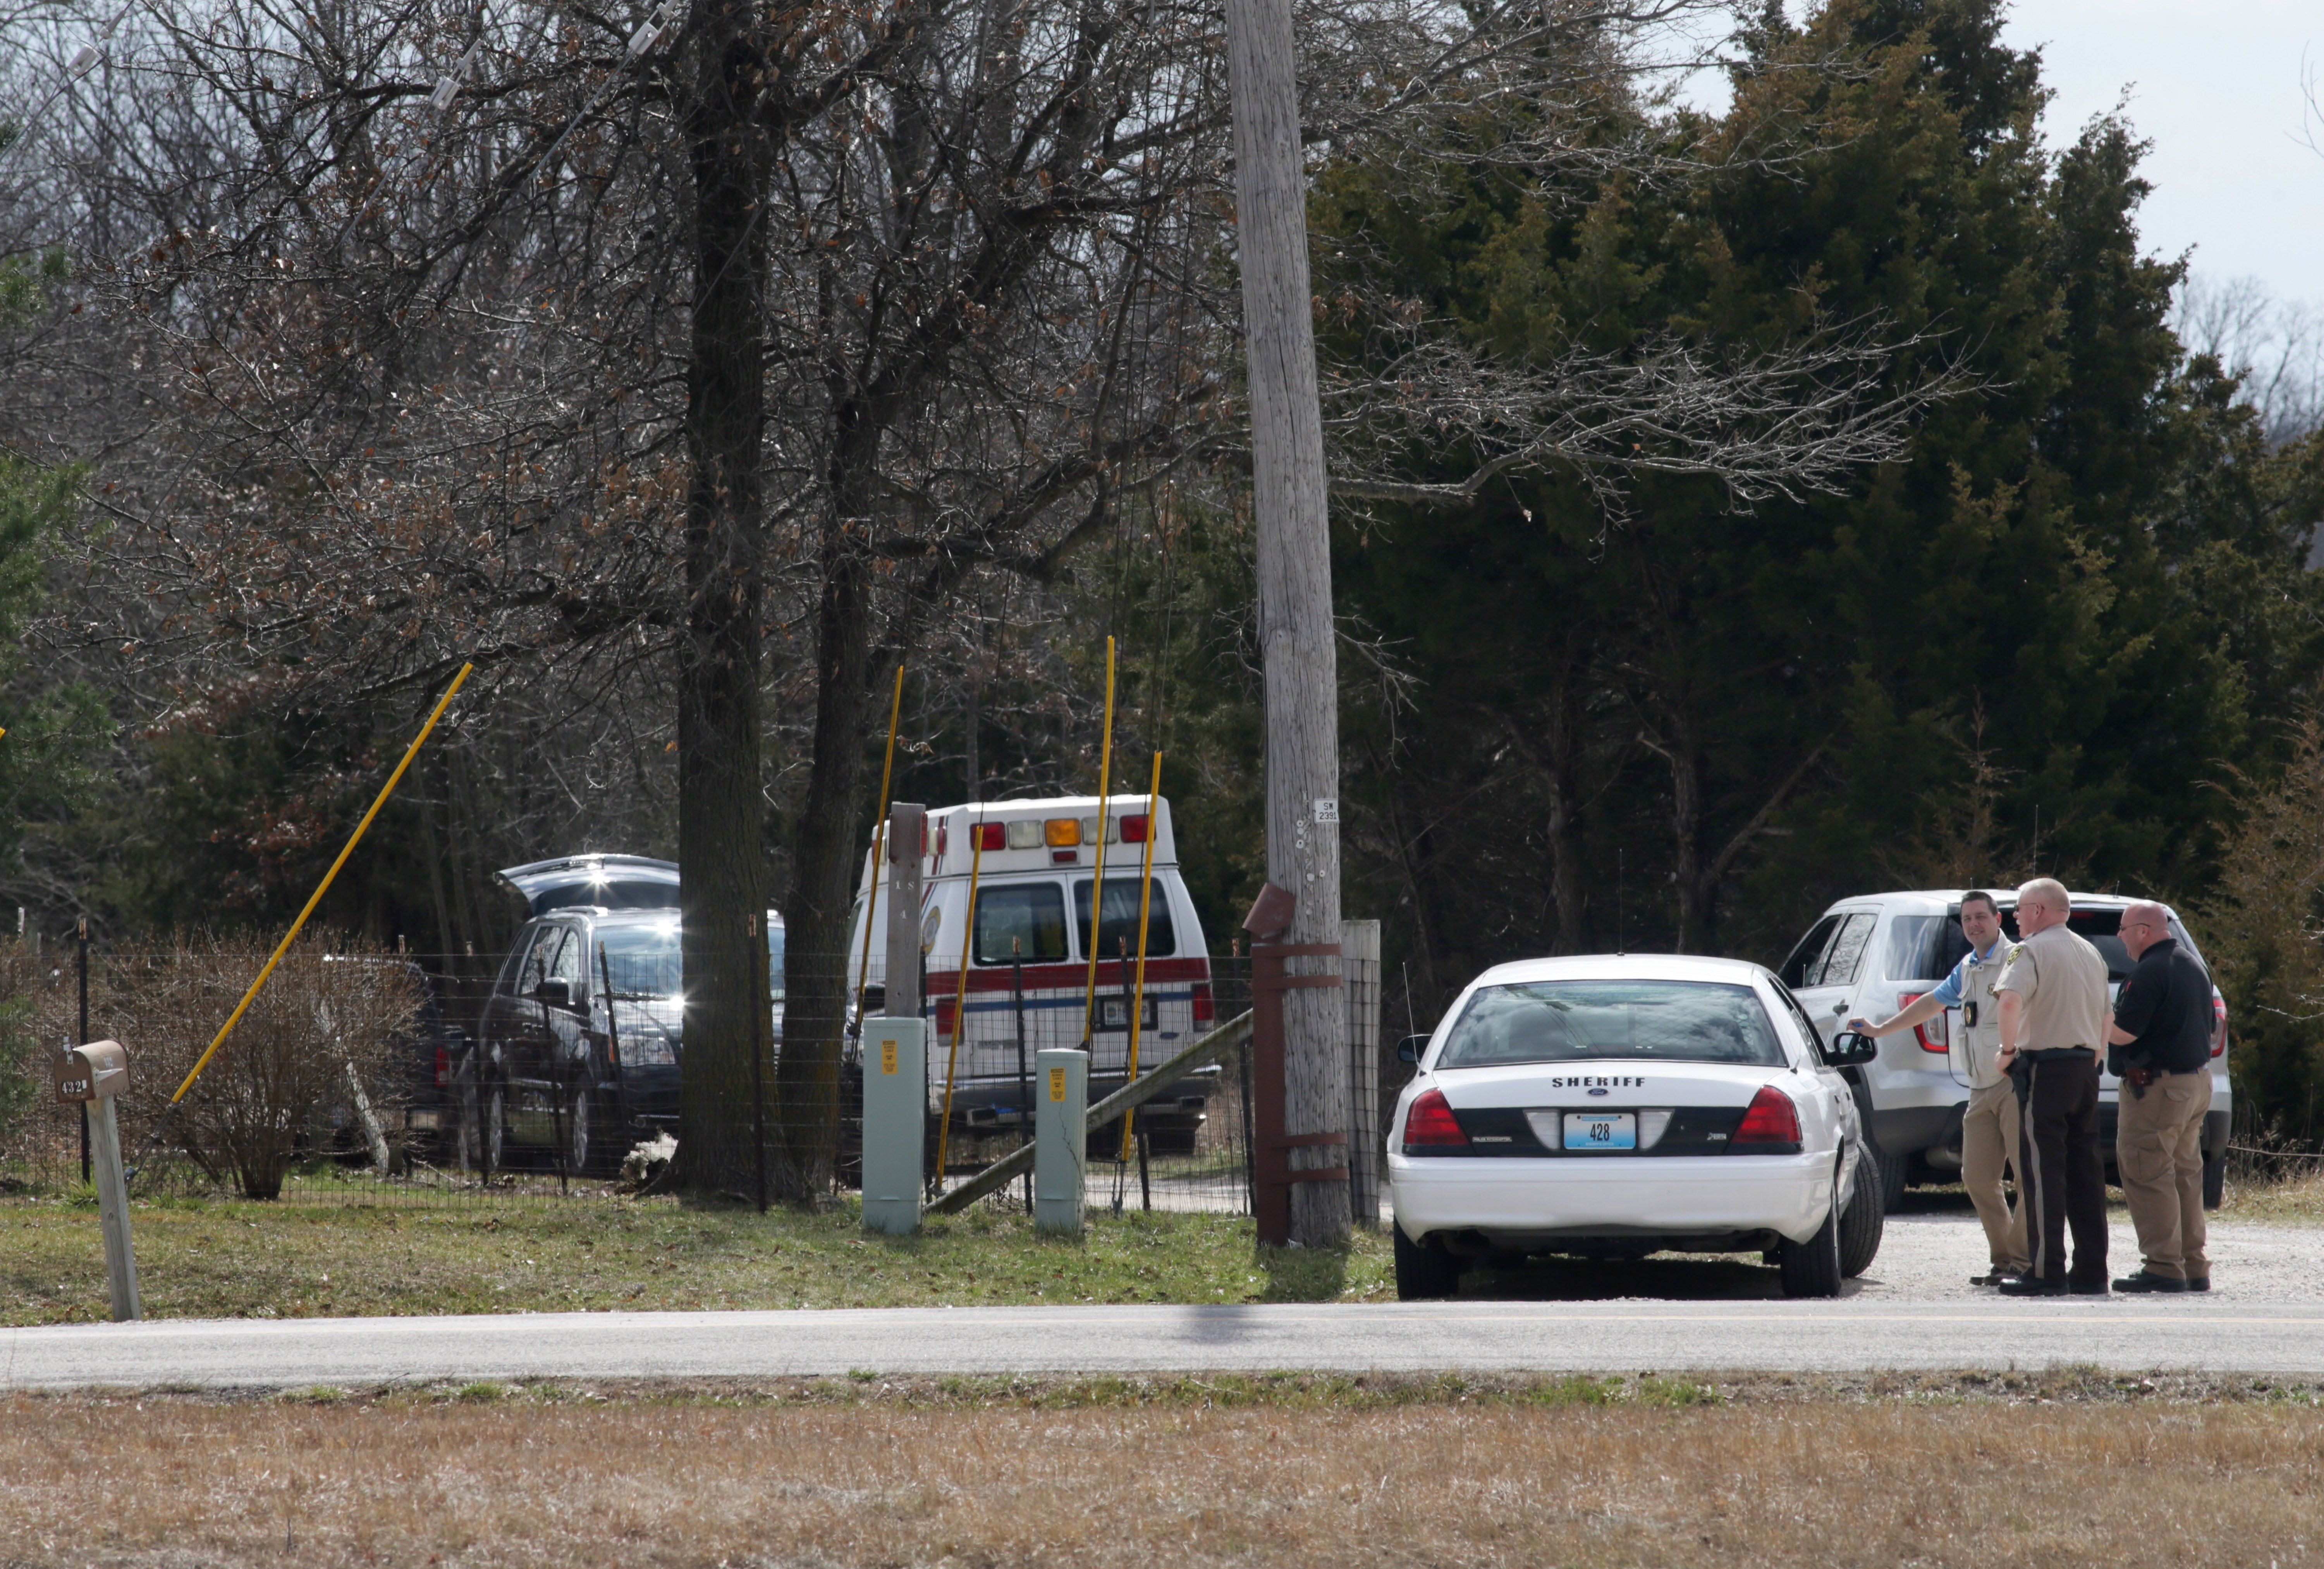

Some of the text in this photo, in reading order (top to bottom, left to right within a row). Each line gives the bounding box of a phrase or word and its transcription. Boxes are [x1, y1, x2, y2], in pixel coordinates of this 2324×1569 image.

[1324, 802, 1333, 810] SW
[1319, 811, 1337, 820] 2391
[900, 910, 907, 919] 4
[1552, 1077, 1645, 1088] SHERIFF
[1590, 1123, 1610, 1141] 428
